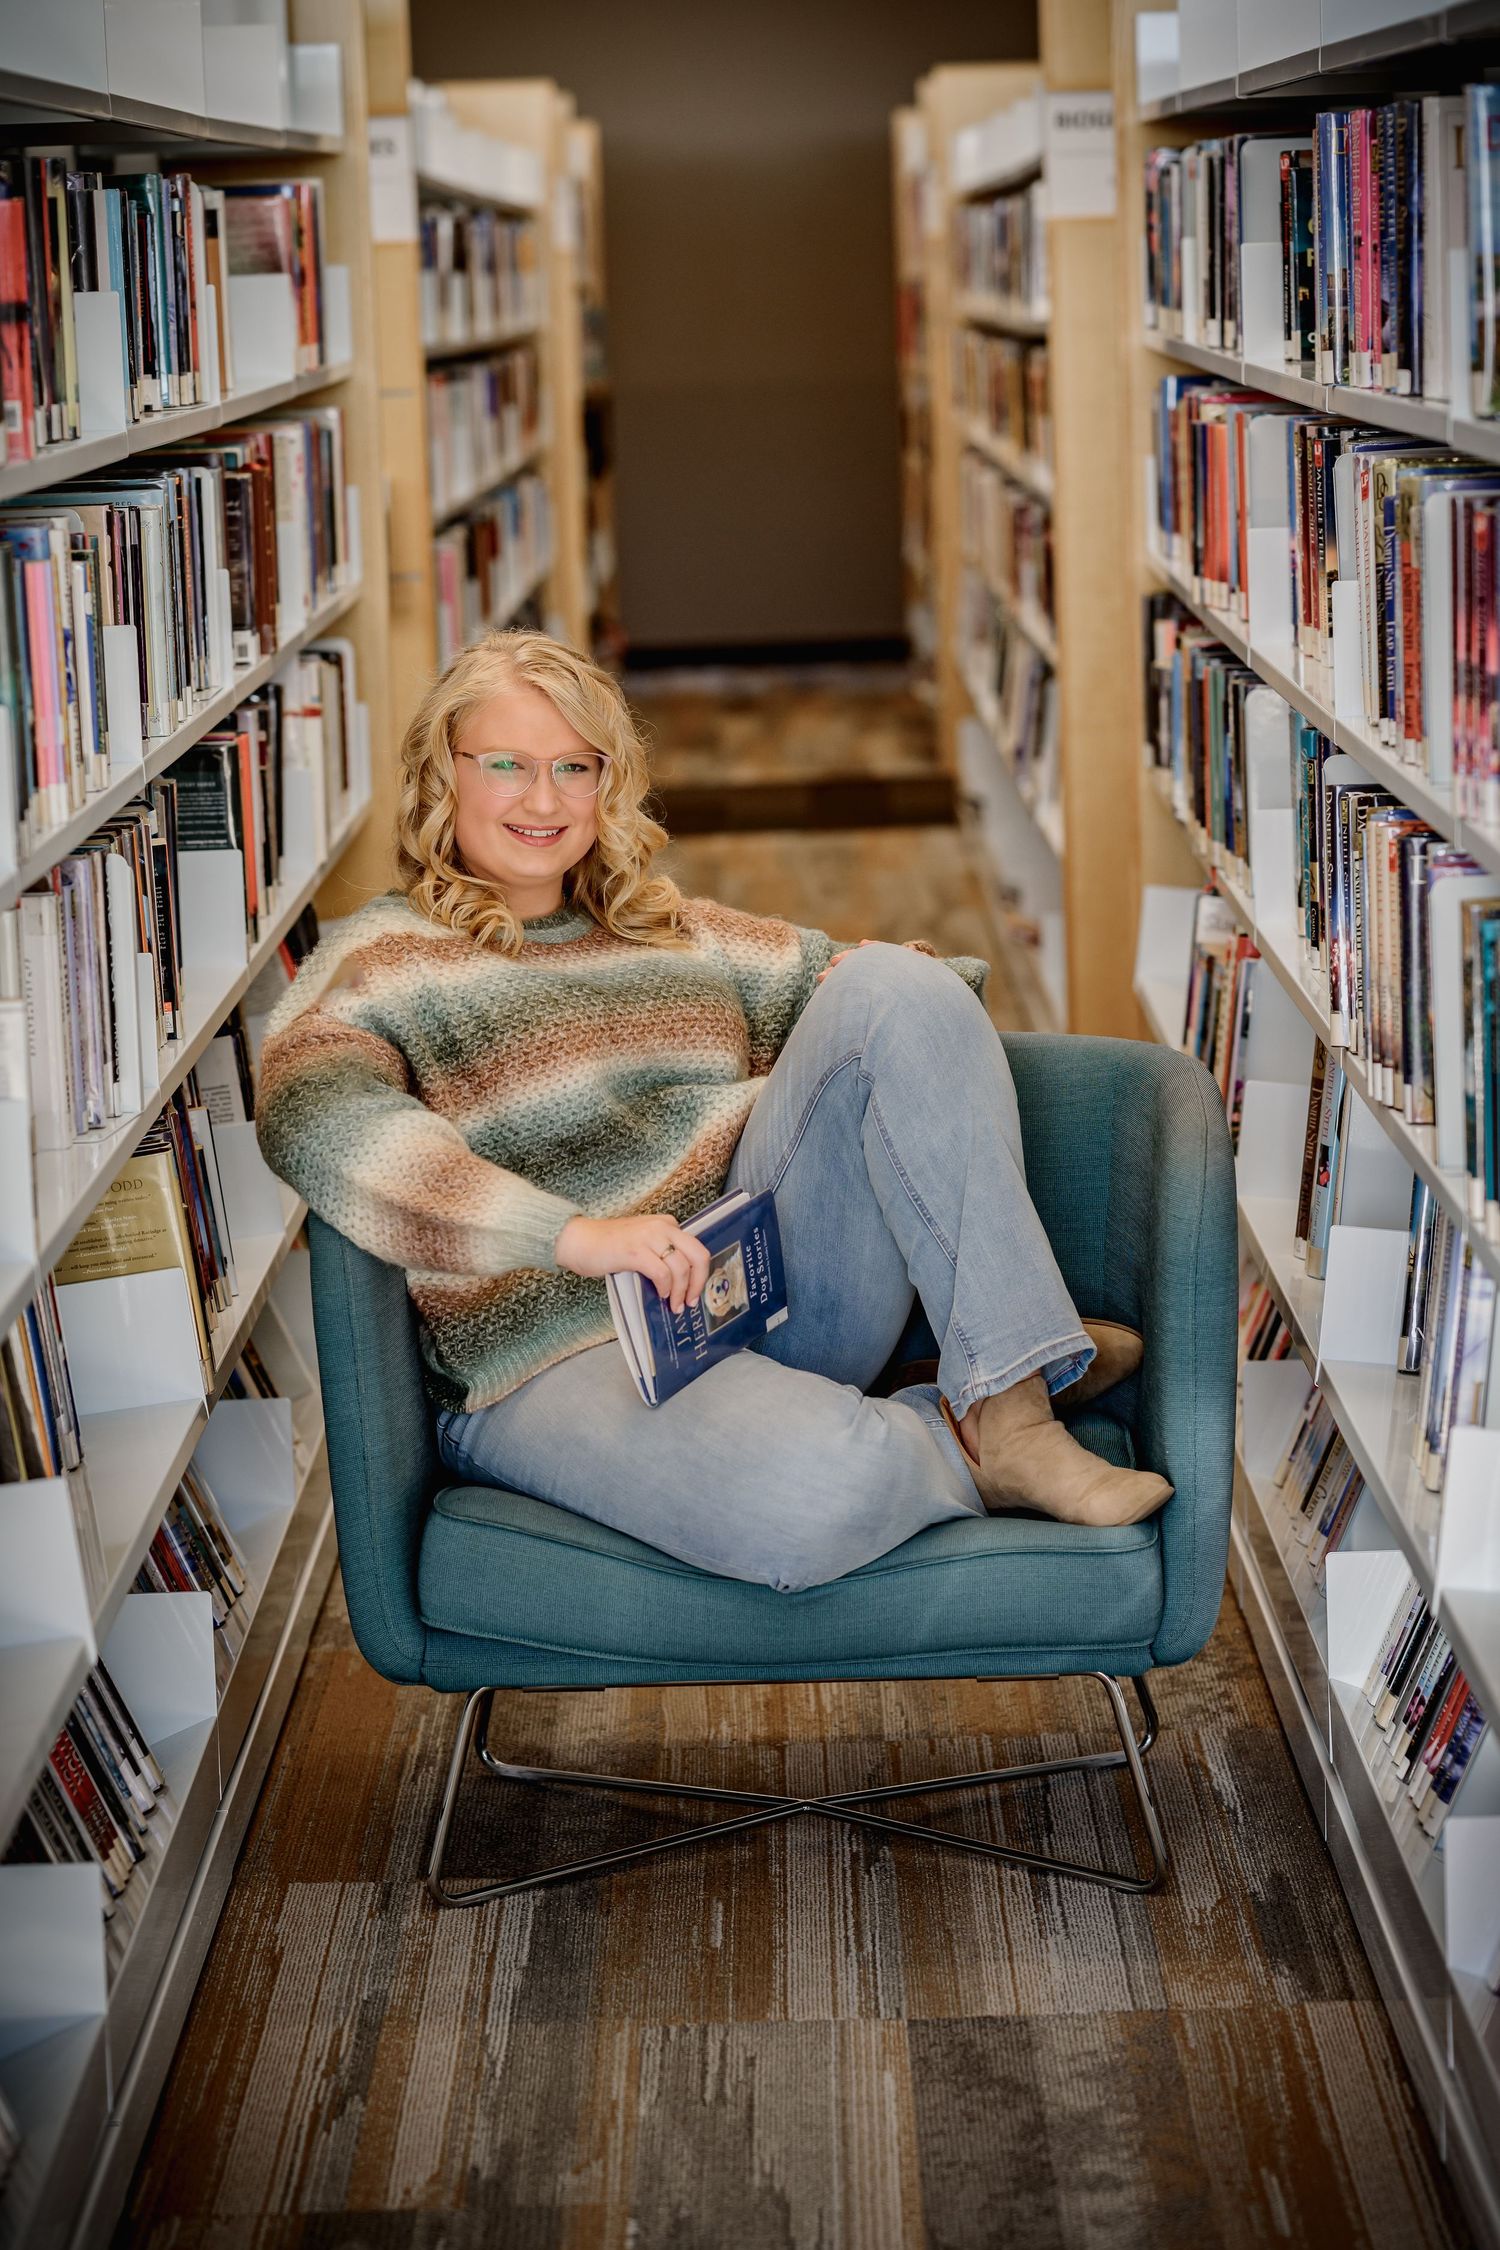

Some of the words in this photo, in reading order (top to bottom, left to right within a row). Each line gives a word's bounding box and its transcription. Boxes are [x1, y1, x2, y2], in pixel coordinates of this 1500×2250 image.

[1386, 112, 1397, 193] DANIELLE
[1387, 198, 1397, 242] STEEL
[1363, 518, 1371, 590] DANIELLE
[1384, 527, 1396, 570] DANIELLE
[1385, 570, 1396, 601] STEEL
[1387, 620, 1396, 647] LEAP
[1387, 655, 1396, 692] FAITH
[1325, 790, 1334, 858] DANIELLE
[1356, 804, 1369, 831] DA
[1326, 862, 1336, 900] STEEL
[1356, 967, 1364, 1013] MALICE
[1308, 1086, 1323, 1132] DANIELLE
[1322, 1106, 1336, 1143] STEEL
[1304, 1131, 1319, 1163] STEEL
[109, 1179, 143, 1195] ODD
[753, 1226, 765, 1274] Stories
[745, 1245, 758, 1299] Favorite
[760, 1274, 769, 1304] Dog
[691, 1304, 708, 1360] HERR
[1303, 1485, 1329, 1521] GHOST
